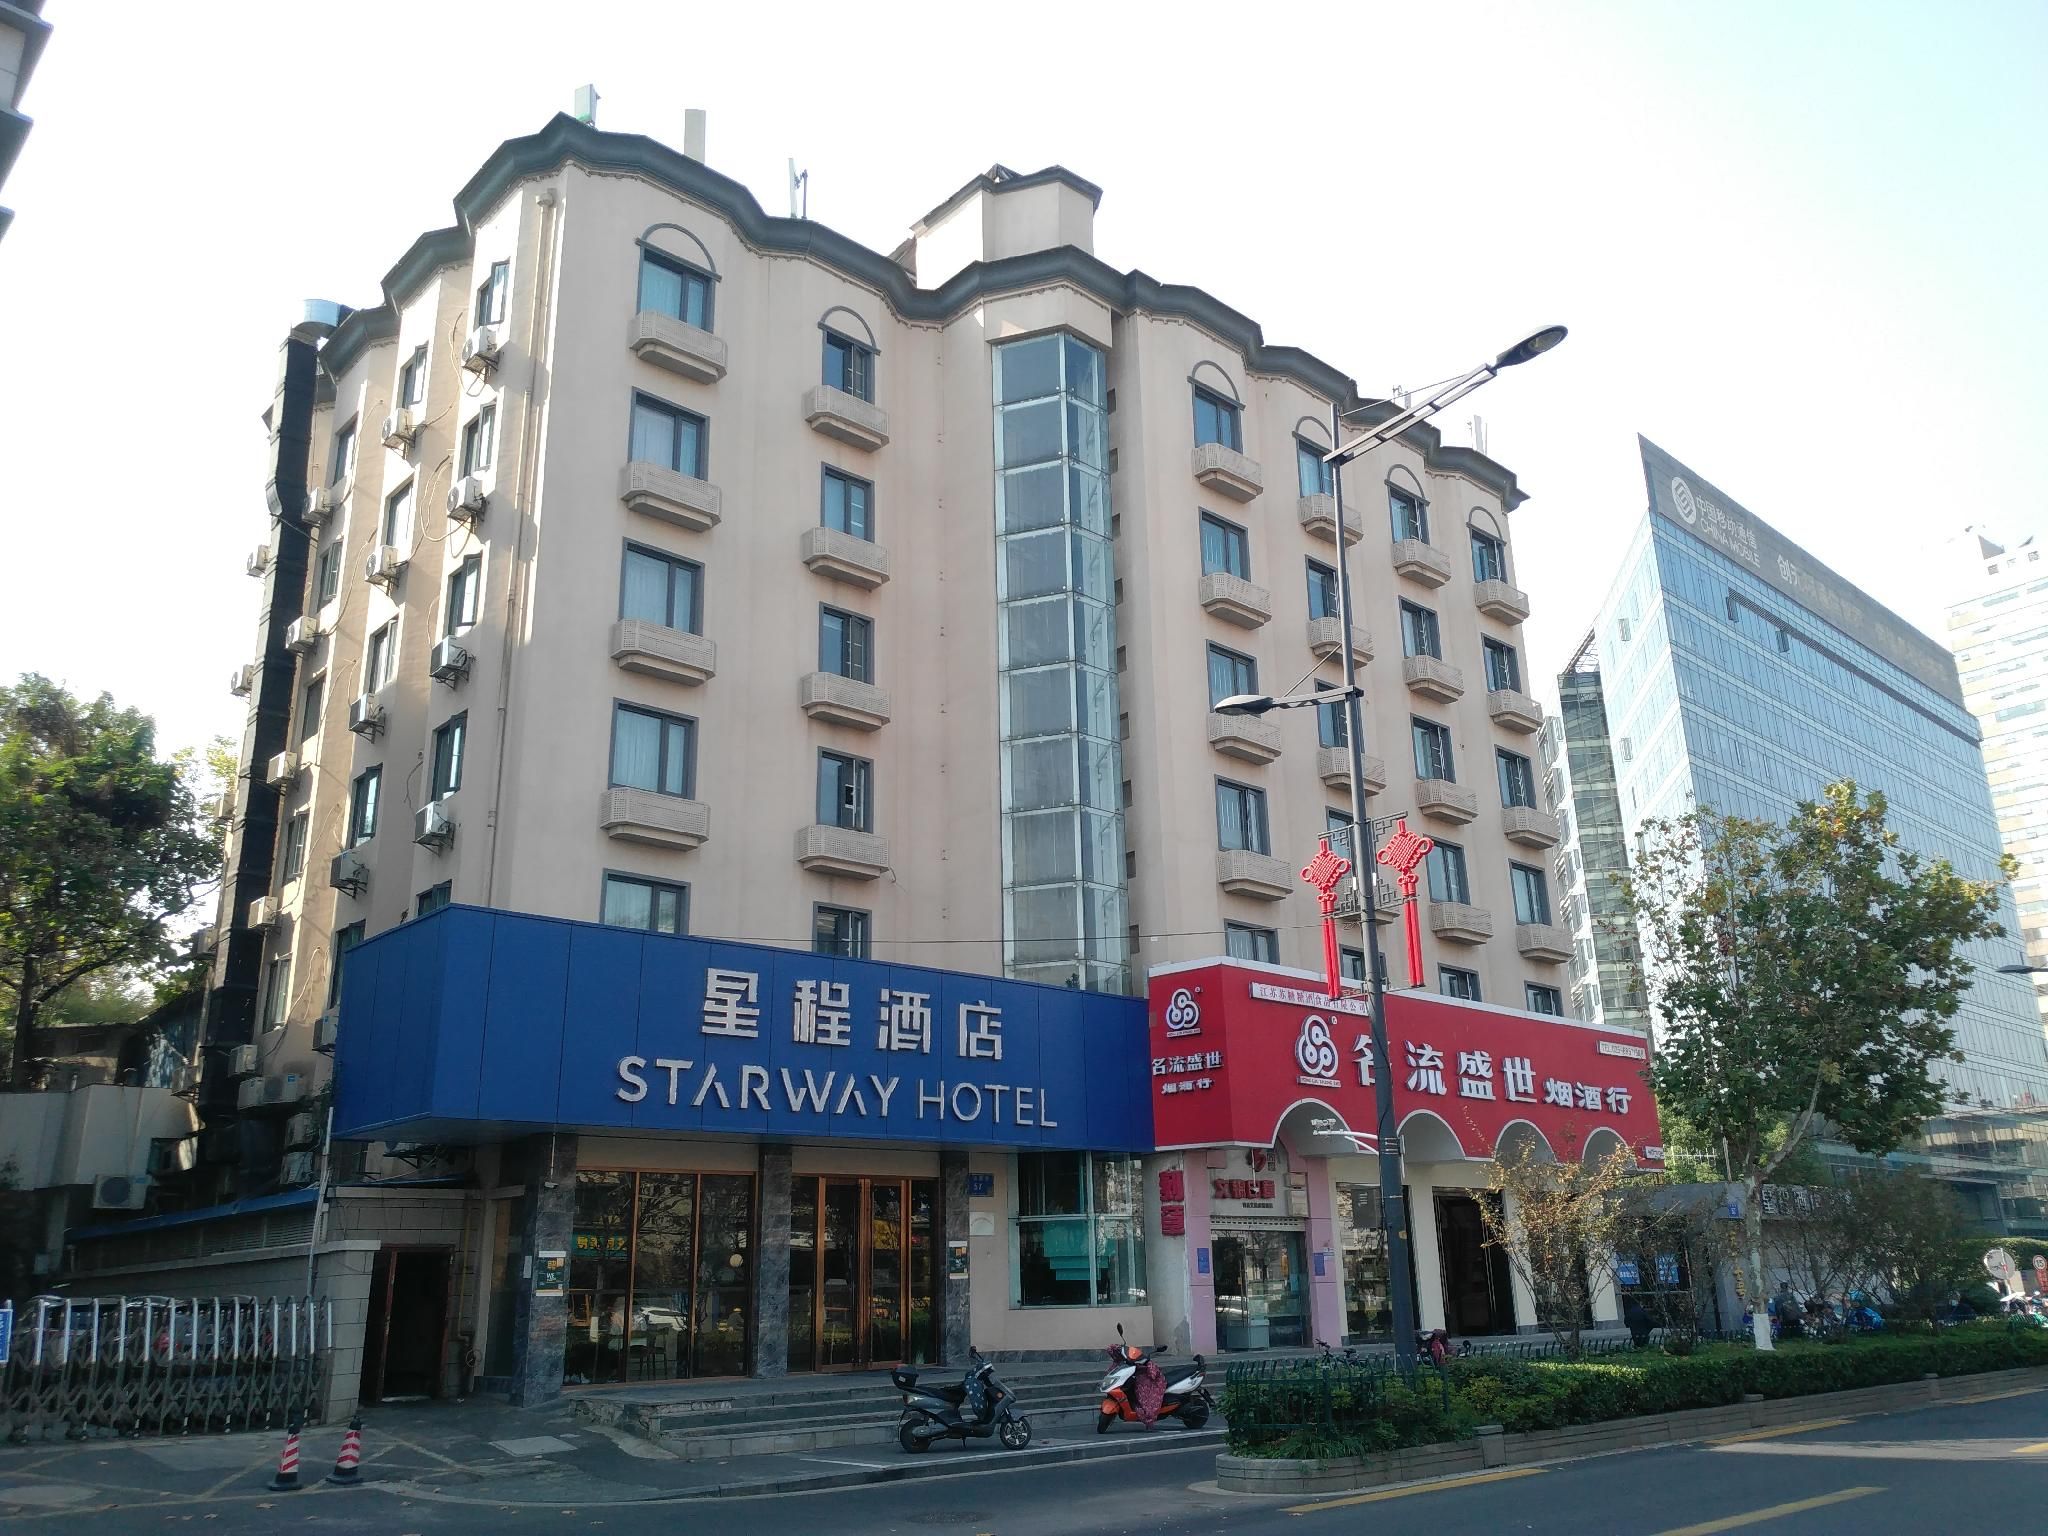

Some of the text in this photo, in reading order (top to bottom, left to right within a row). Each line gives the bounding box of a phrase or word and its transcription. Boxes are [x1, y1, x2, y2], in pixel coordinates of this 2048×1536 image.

[1700, 518, 1761, 568] CHINA MOBILE
[700, 967, 1003, 1060] 星程酒店
[1152, 1051, 1224, 1076] 名流盛世
[614, 1055, 1059, 1128] STARWAY HOTEL
[1161, 1077, 1214, 1096] 烟酒行
[1544, 1077, 1633, 1115] 烟酒行
[2035, 1259, 2044, 1268] 15
